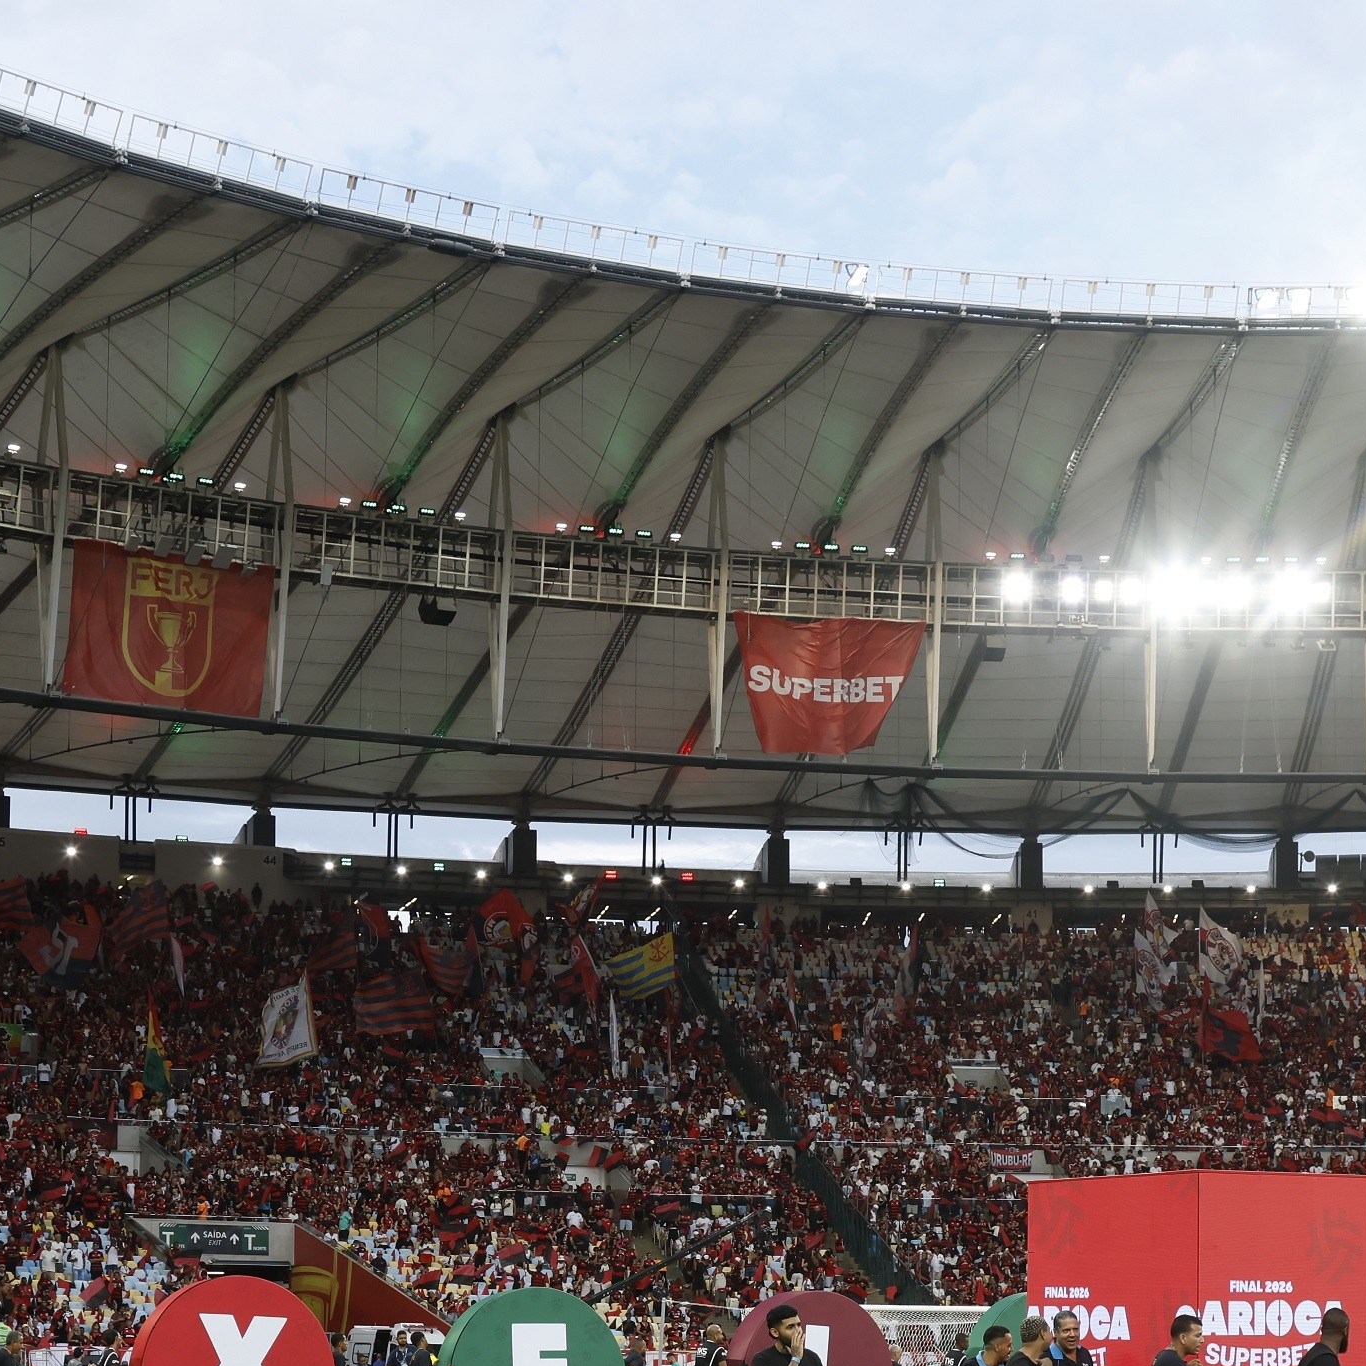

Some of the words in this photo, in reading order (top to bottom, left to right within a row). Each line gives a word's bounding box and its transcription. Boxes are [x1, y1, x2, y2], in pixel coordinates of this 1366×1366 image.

[130, 562, 215, 600] FERJ
[748, 664, 905, 703] SUPERBET
[263, 855, 277, 865] 44
[773, 905, 784, 915] 42
[1026, 909, 1037, 919] 41
[203, 1230, 227, 1239] SAÍDA
[243, 1233, 256, 1251] T
[1044, 1286, 1068, 1298] FINAL
[1069, 1286, 1090, 1299] 2026
[1229, 1280, 1263, 1293] FINAL
[1264, 1280, 1294, 1294] 2026
